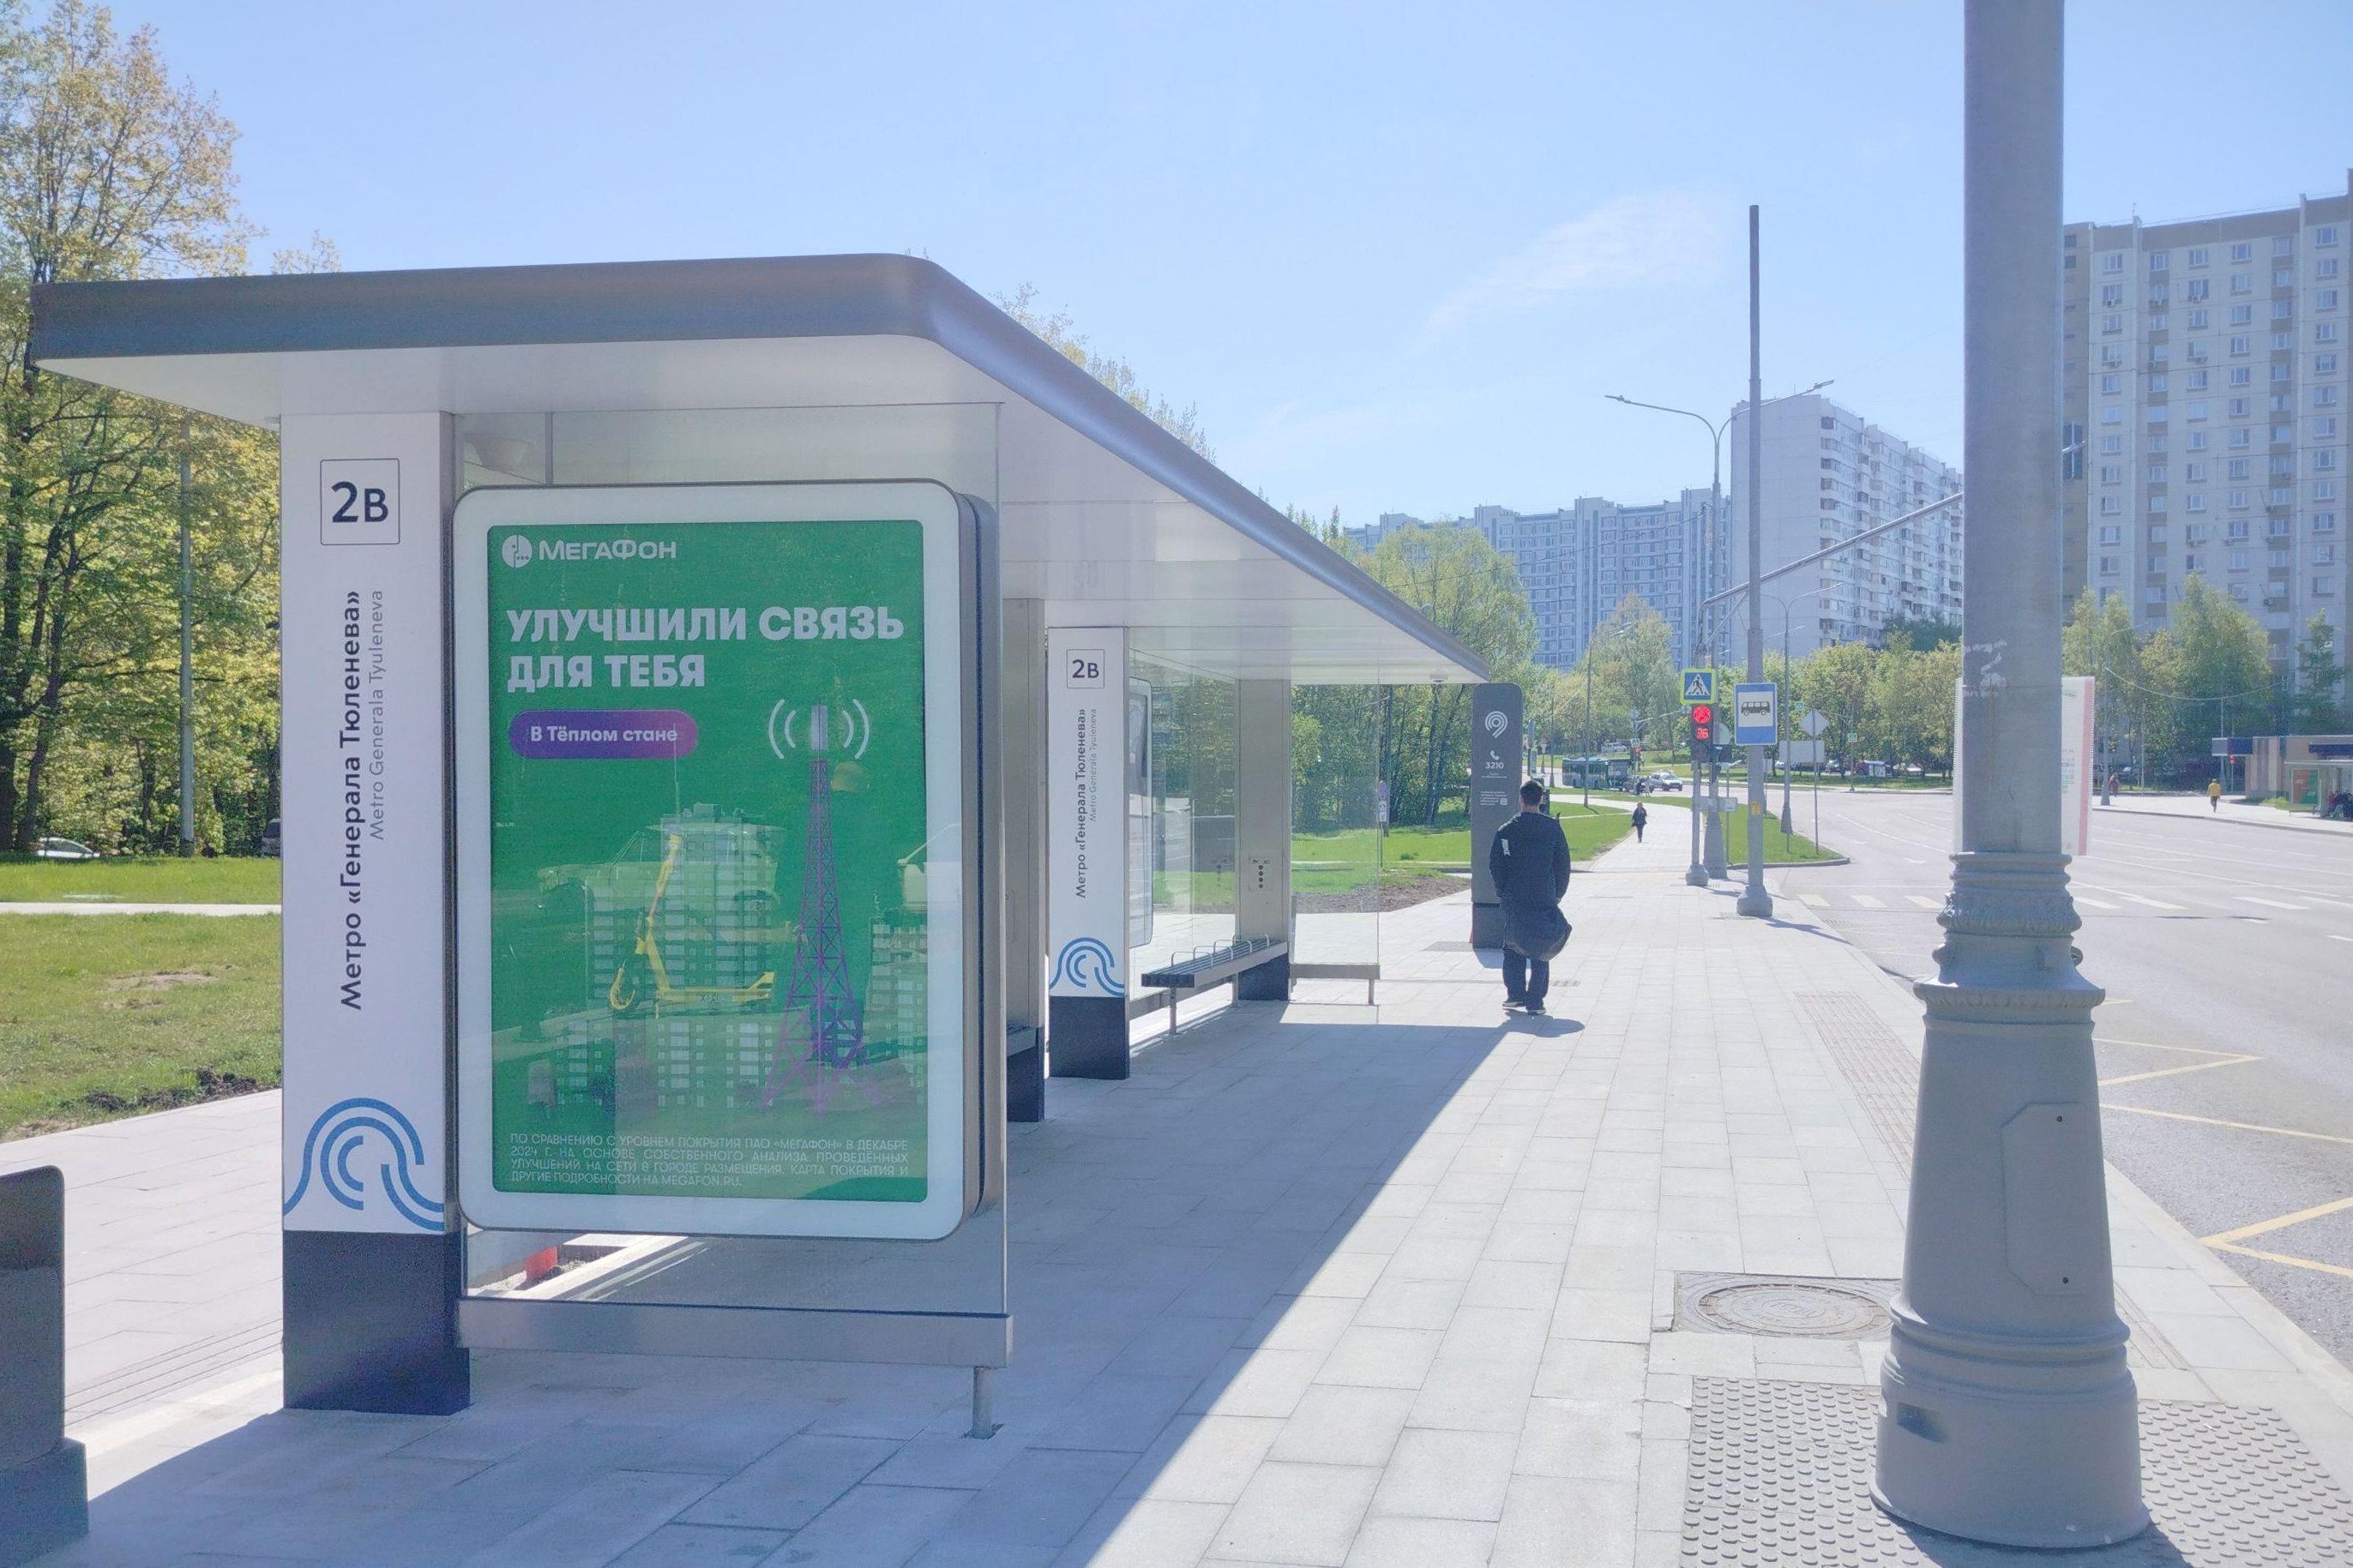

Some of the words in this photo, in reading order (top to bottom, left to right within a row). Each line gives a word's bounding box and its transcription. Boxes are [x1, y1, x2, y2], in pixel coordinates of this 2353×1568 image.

[368, 591, 386, 684] Tyuleneva
[507, 608, 746, 643] УЛУЧШИЛИ
[759, 605, 905, 640] СВЯЗЬ
[340, 592, 360, 748] Тюленева»
[507, 655, 593, 694] ДЛЯ
[605, 654, 705, 688] ТЕБЯ
[369, 689, 383, 772] Generala
[530, 726, 542, 742] В
[546, 725, 618, 742] Тёплом
[623, 727, 678, 742] стане
[1075, 709, 1086, 780] Тюленева»
[1089, 709, 1098, 752] Tyuleneva
[340, 759, 367, 904] «Генерала
[370, 781, 383, 840] Metro
[1075, 784, 1088, 850] «Генерала
[1075, 855, 1088, 898] Метро
[340, 913, 366, 1011] Метро
[510, 1133, 527, 1144] ПО
[532, 1134, 603, 1146] СРАВНЕНИЮ
[606, 1136, 615, 1145] С
[621, 1137, 674, 1147] УРОВНЕМ
[678, 1137, 741, 1149] ПОКРЫТИЯ
[744, 1138, 770, 1149] ПАО
[773, 1138, 842, 1150] «МЕГАФОН»
[846, 1139, 853, 1150] В
[858, 1139, 908, 1151] ДЕКАБРЕ
[511, 1146, 537, 1156] 2024
[560, 1147, 575, 1157] НА
[583, 1147, 635, 1158] ОСНОВЕ
[644, 1149, 742, 1161] СОБСТВЕННОГО
[753, 1150, 807, 1162] АНАЛИЗА
[511, 1171, 551, 1182] ДРУГИЕ
[554, 1172, 640, 1184] ПОДРОБНОСТИ
[644, 1174, 658, 1184] НА
[587, 1161, 600, 1170] НА
[606, 1162, 637, 1172] СЕТИ
[642, 1162, 648, 1172] В
[654, 1162, 698, 1174] ГОРОДЕ
[791, 1165, 825, 1175] КАРТА
[830, 1165, 894, 1176] ПОКРЫТИЯ
[901, 1166, 908, 1176] И
